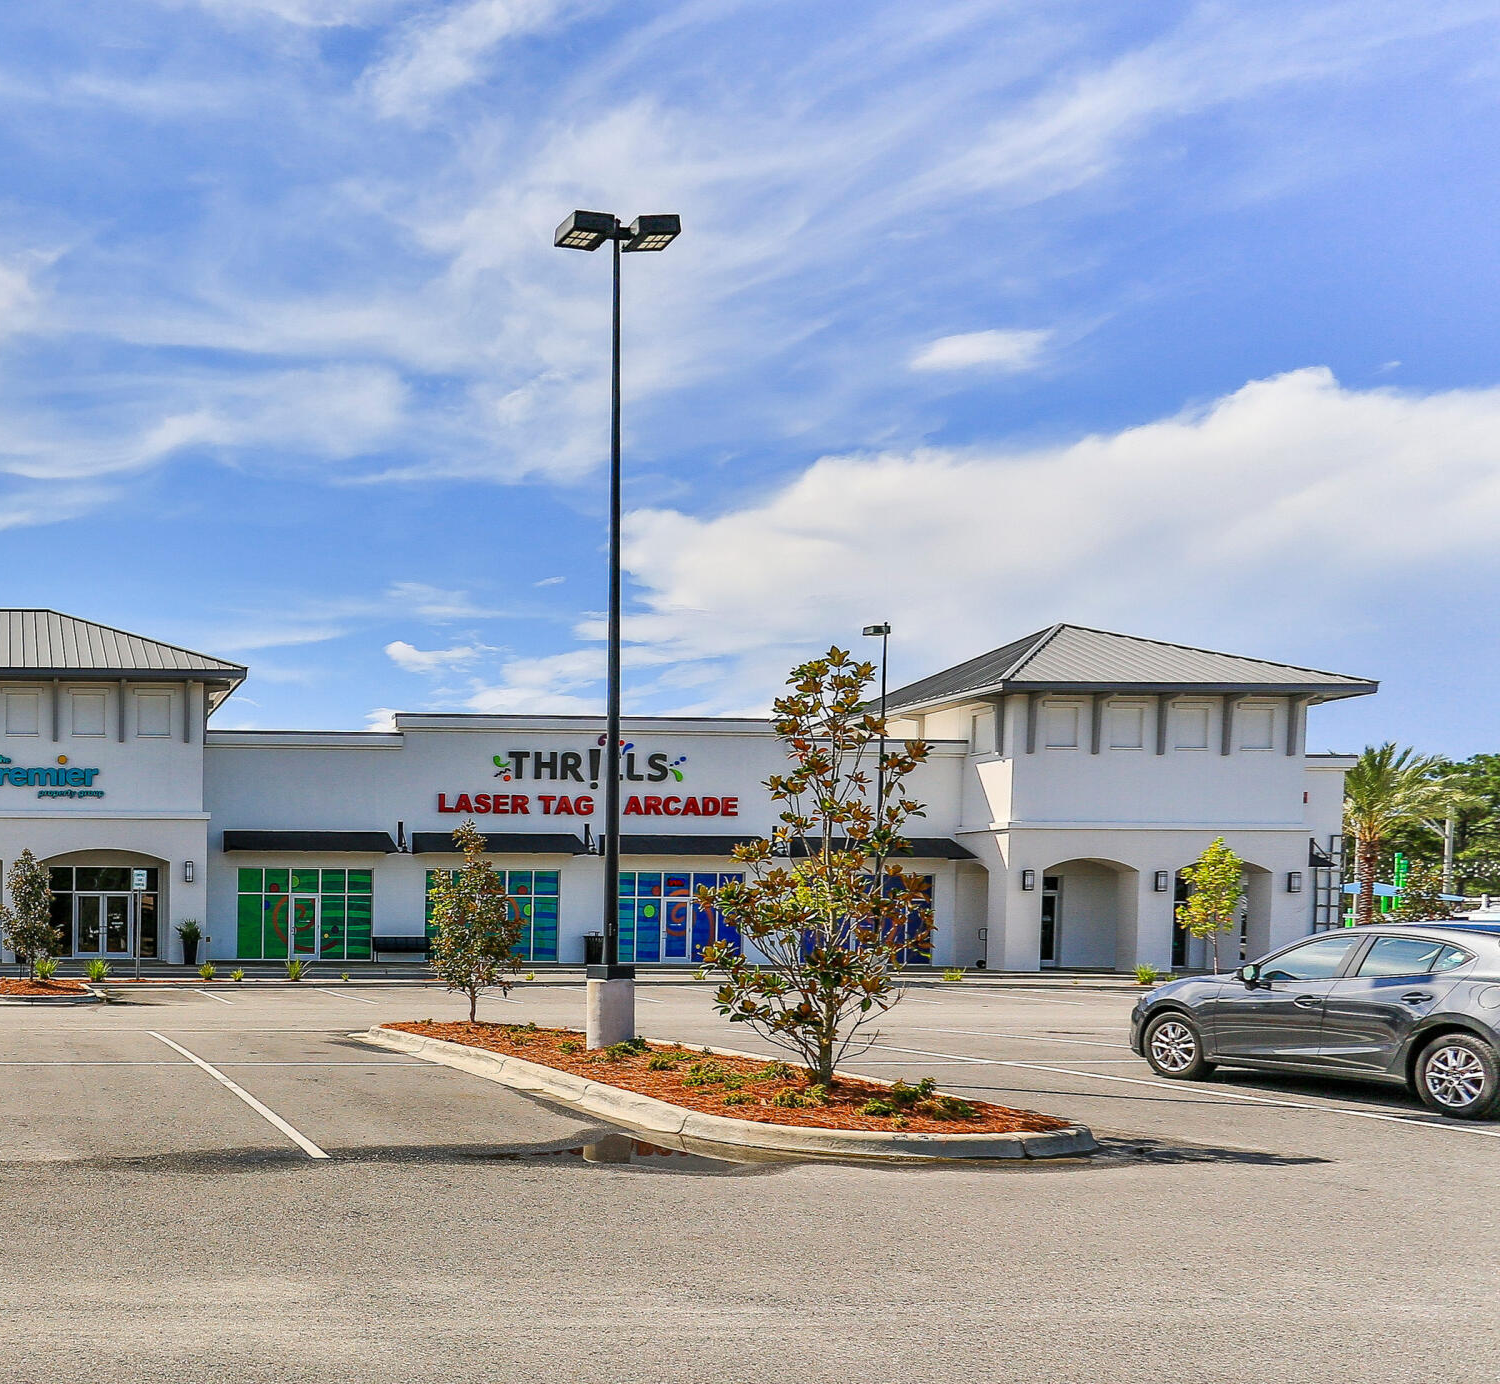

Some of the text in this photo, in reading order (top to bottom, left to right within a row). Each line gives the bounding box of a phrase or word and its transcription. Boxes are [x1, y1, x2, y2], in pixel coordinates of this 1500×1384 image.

[508, 748, 669, 789] THR!LS
[37, 789, 104, 799] property group
[438, 793, 739, 817] LASER TAG ARCADE
